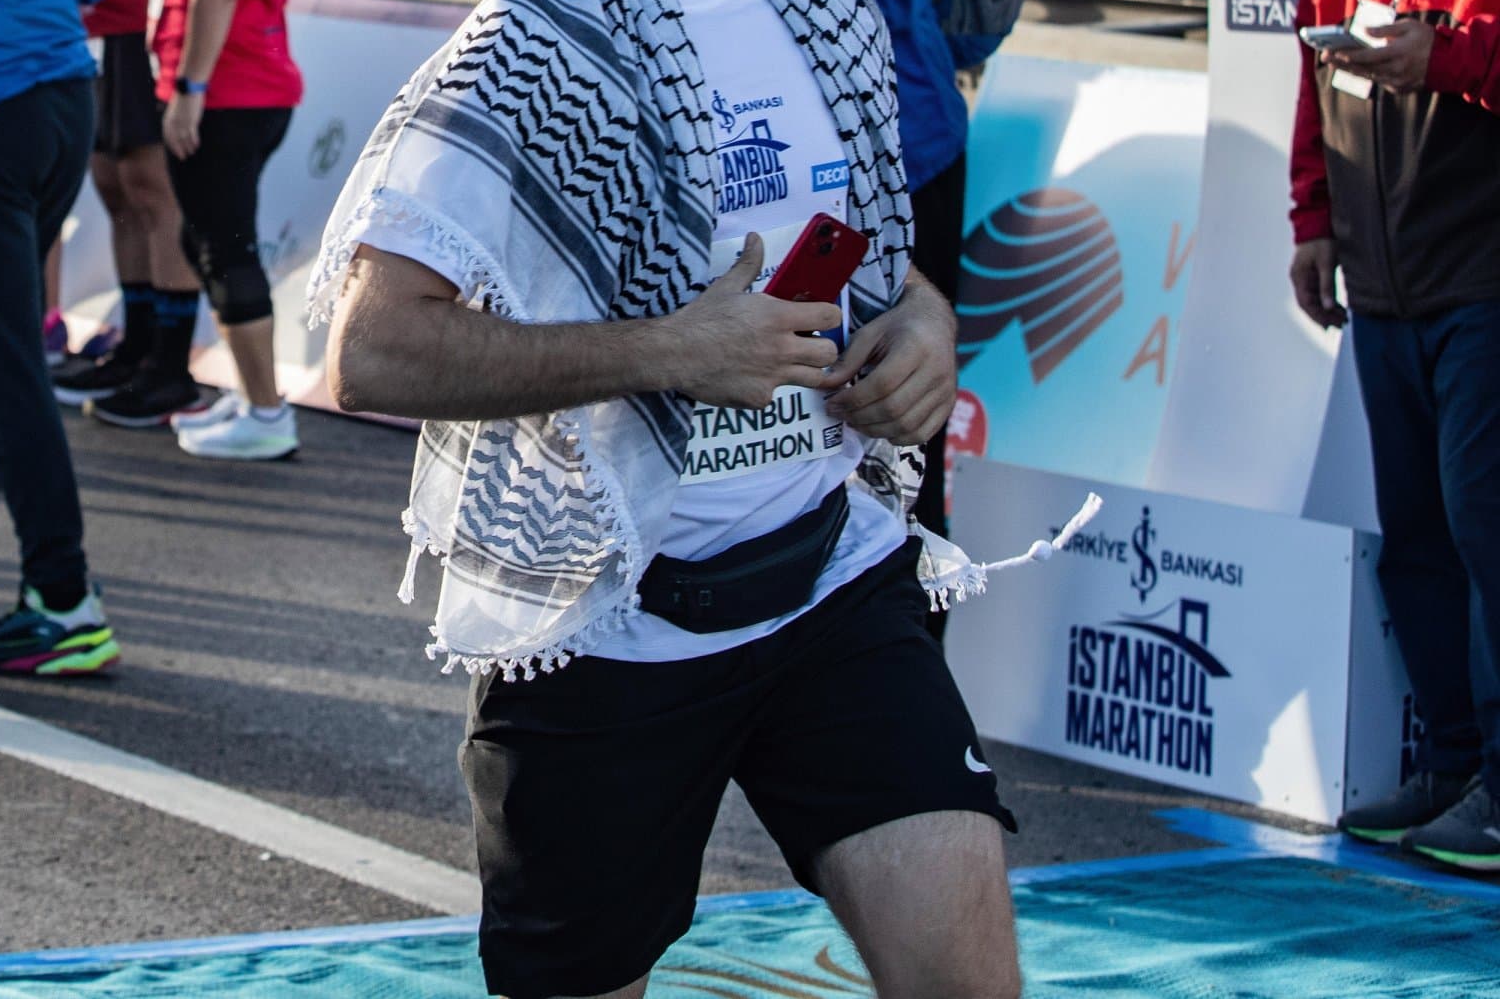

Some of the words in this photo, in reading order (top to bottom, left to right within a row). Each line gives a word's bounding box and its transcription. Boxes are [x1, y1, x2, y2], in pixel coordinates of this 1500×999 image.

[733, 96, 784, 116] BANKASI
[719, 146, 785, 184] ANBUL
[718, 172, 788, 214] ARATONU
[688, 391, 811, 440] TANBUL
[1160, 551, 1244, 587] BANKASI
[1065, 689, 1214, 777] MARATHON
